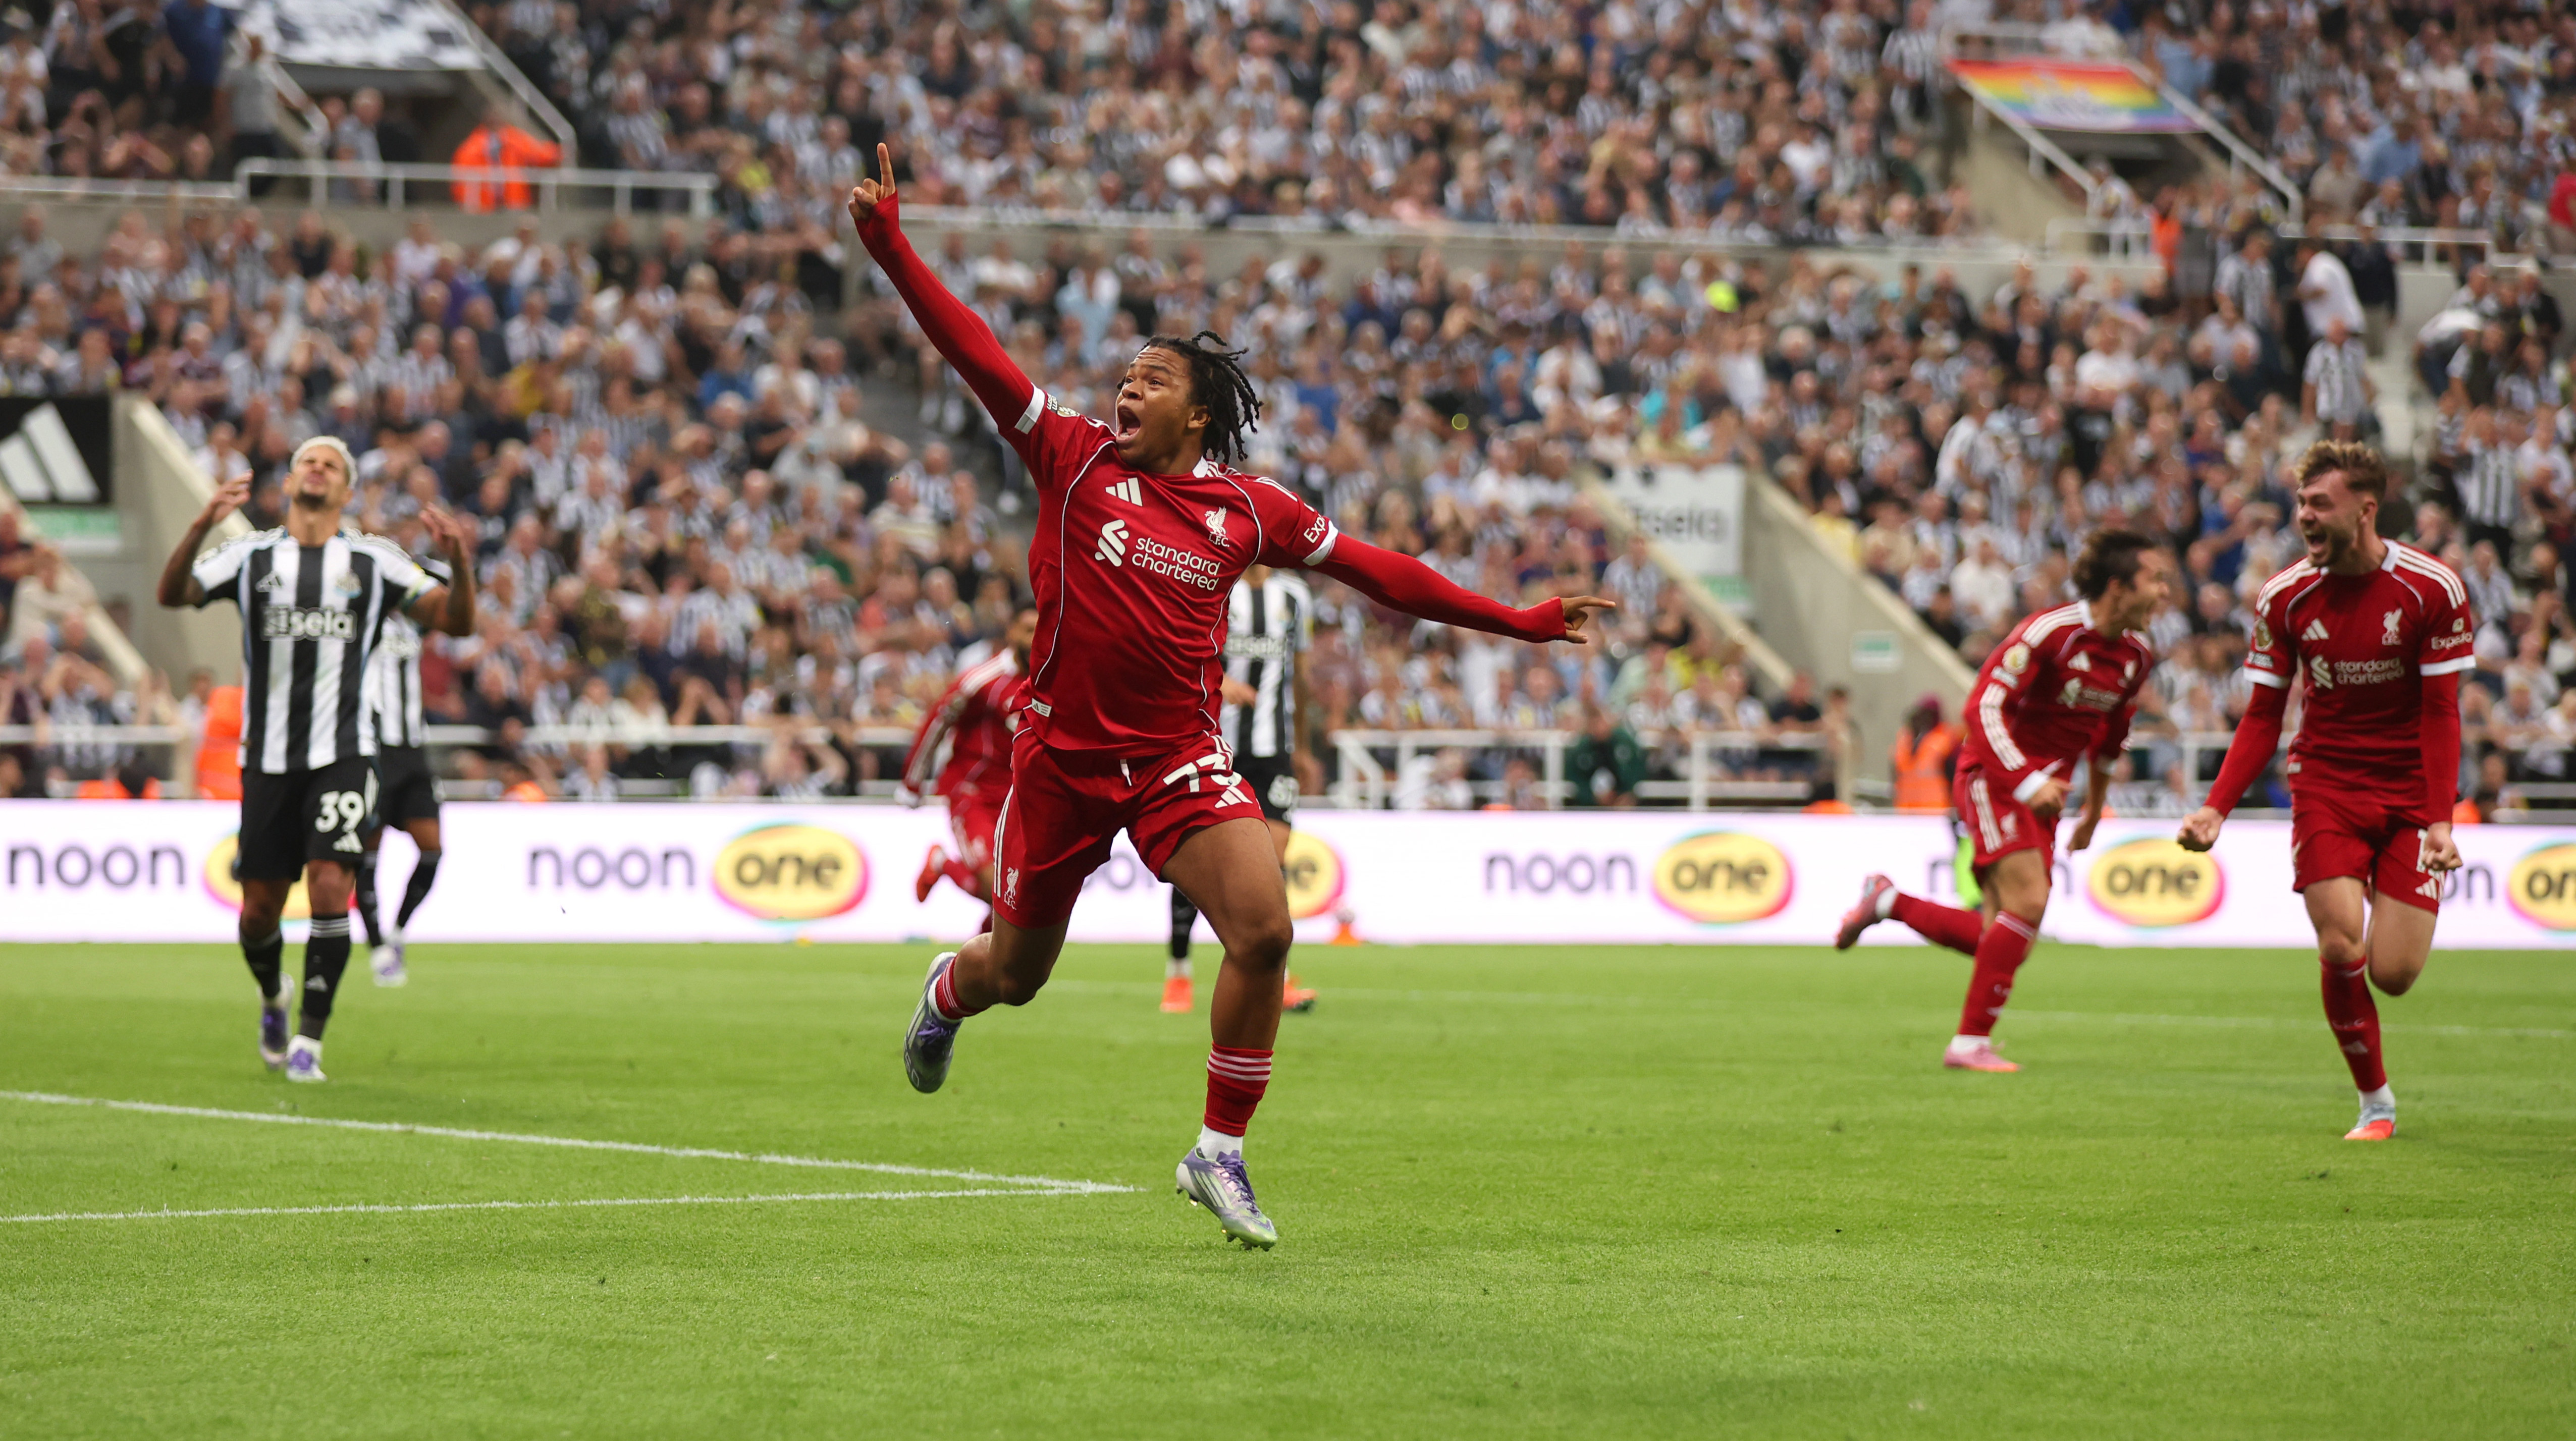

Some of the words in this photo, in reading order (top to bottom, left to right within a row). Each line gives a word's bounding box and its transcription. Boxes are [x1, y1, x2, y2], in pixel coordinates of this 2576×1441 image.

[1304, 513, 1326, 543] Exp
[1132, 553, 1219, 591] chartered
[1136, 537, 1221, 576] standard
[1162, 752, 1243, 793] 73
[314, 790, 365, 833] 39
[9, 846, 185, 886] noon
[529, 848, 695, 888] noon
[735, 853, 842, 889] one
[1486, 855, 1637, 893] noon
[1672, 859, 1769, 893] one
[2106, 864, 2199, 897] one
[2527, 869, 2576, 901] on
